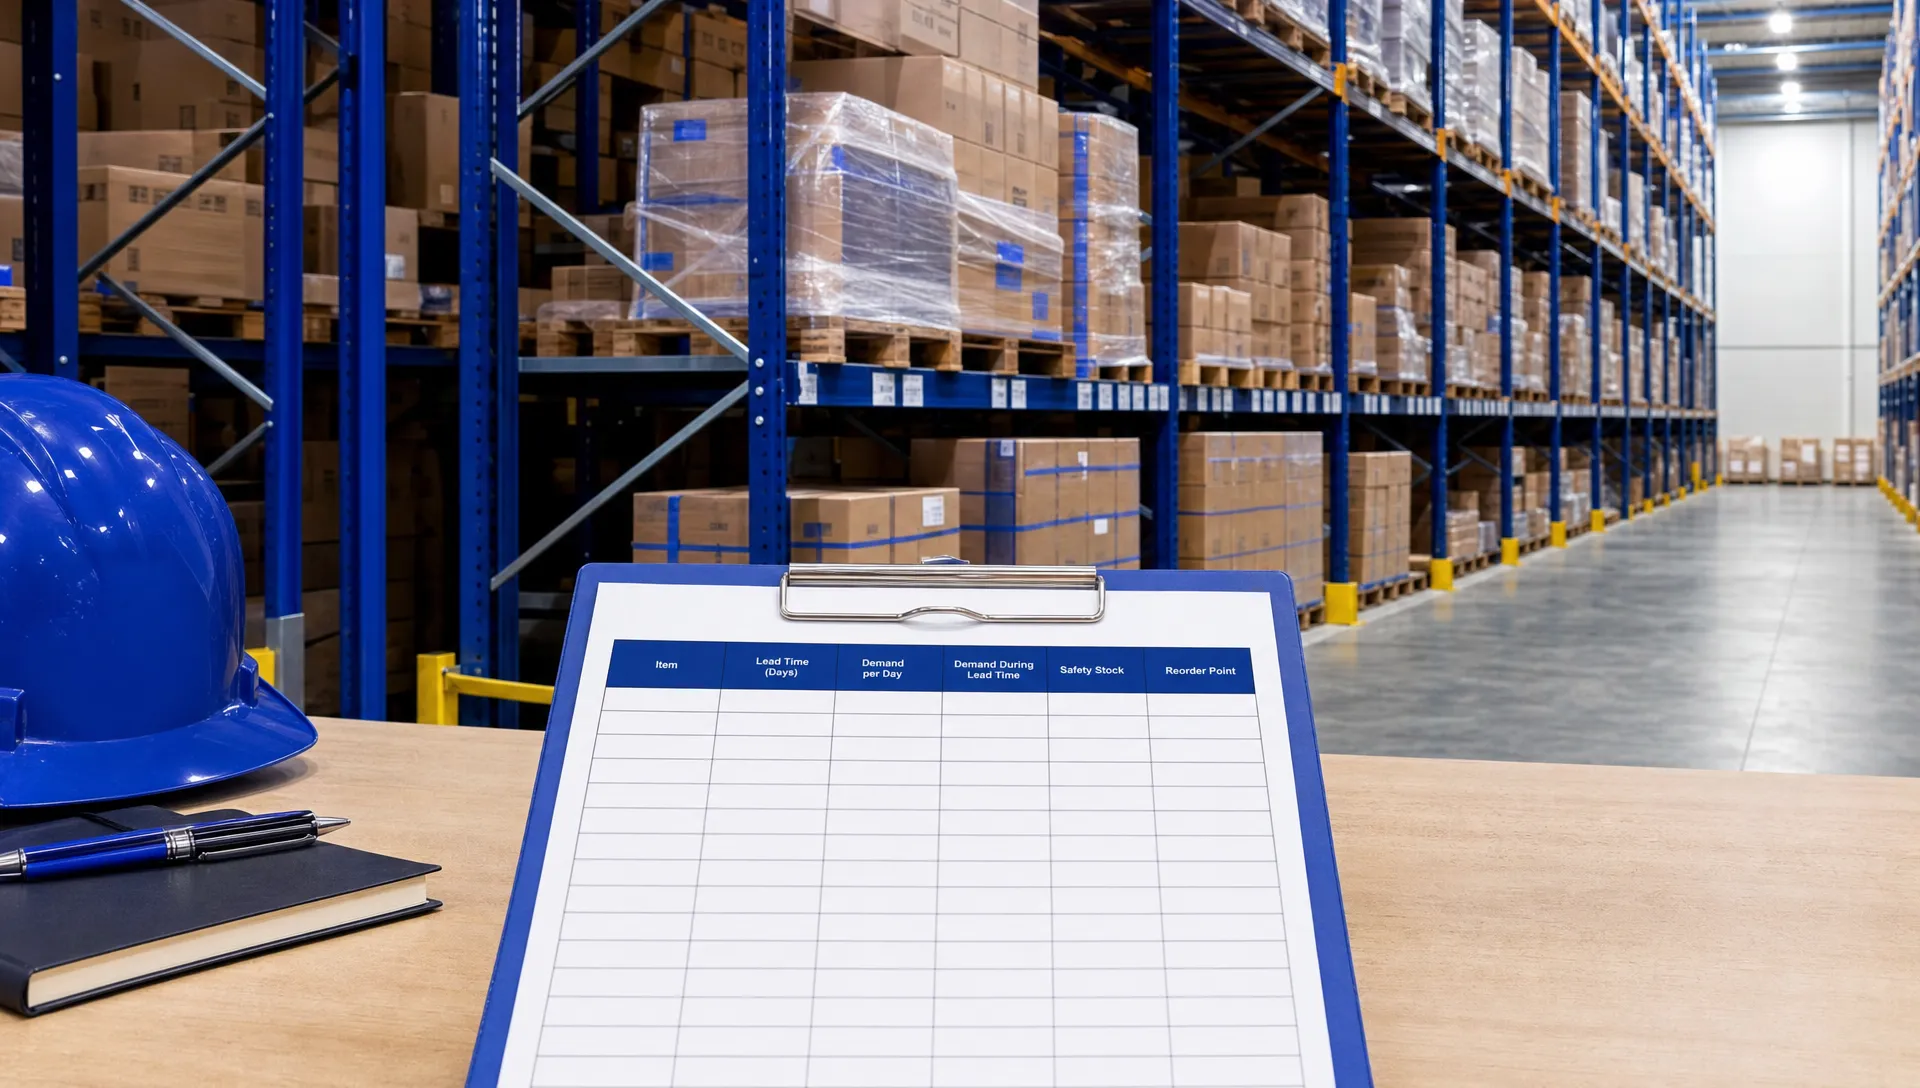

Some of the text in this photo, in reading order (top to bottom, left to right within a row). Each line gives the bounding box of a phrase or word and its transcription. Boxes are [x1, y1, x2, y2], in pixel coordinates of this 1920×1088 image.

[655, 660, 678, 669] Item
[755, 656, 809, 666] Lead Time
[862, 658, 905, 668] Demand
[954, 659, 1034, 671] Demand During
[764, 667, 799, 678] (Days)
[862, 669, 903, 680] per Day
[967, 670, 1021, 680] Lead Time
[1060, 665, 1125, 676] Safety Stock
[1165, 666, 1237, 675] Reorder Point
